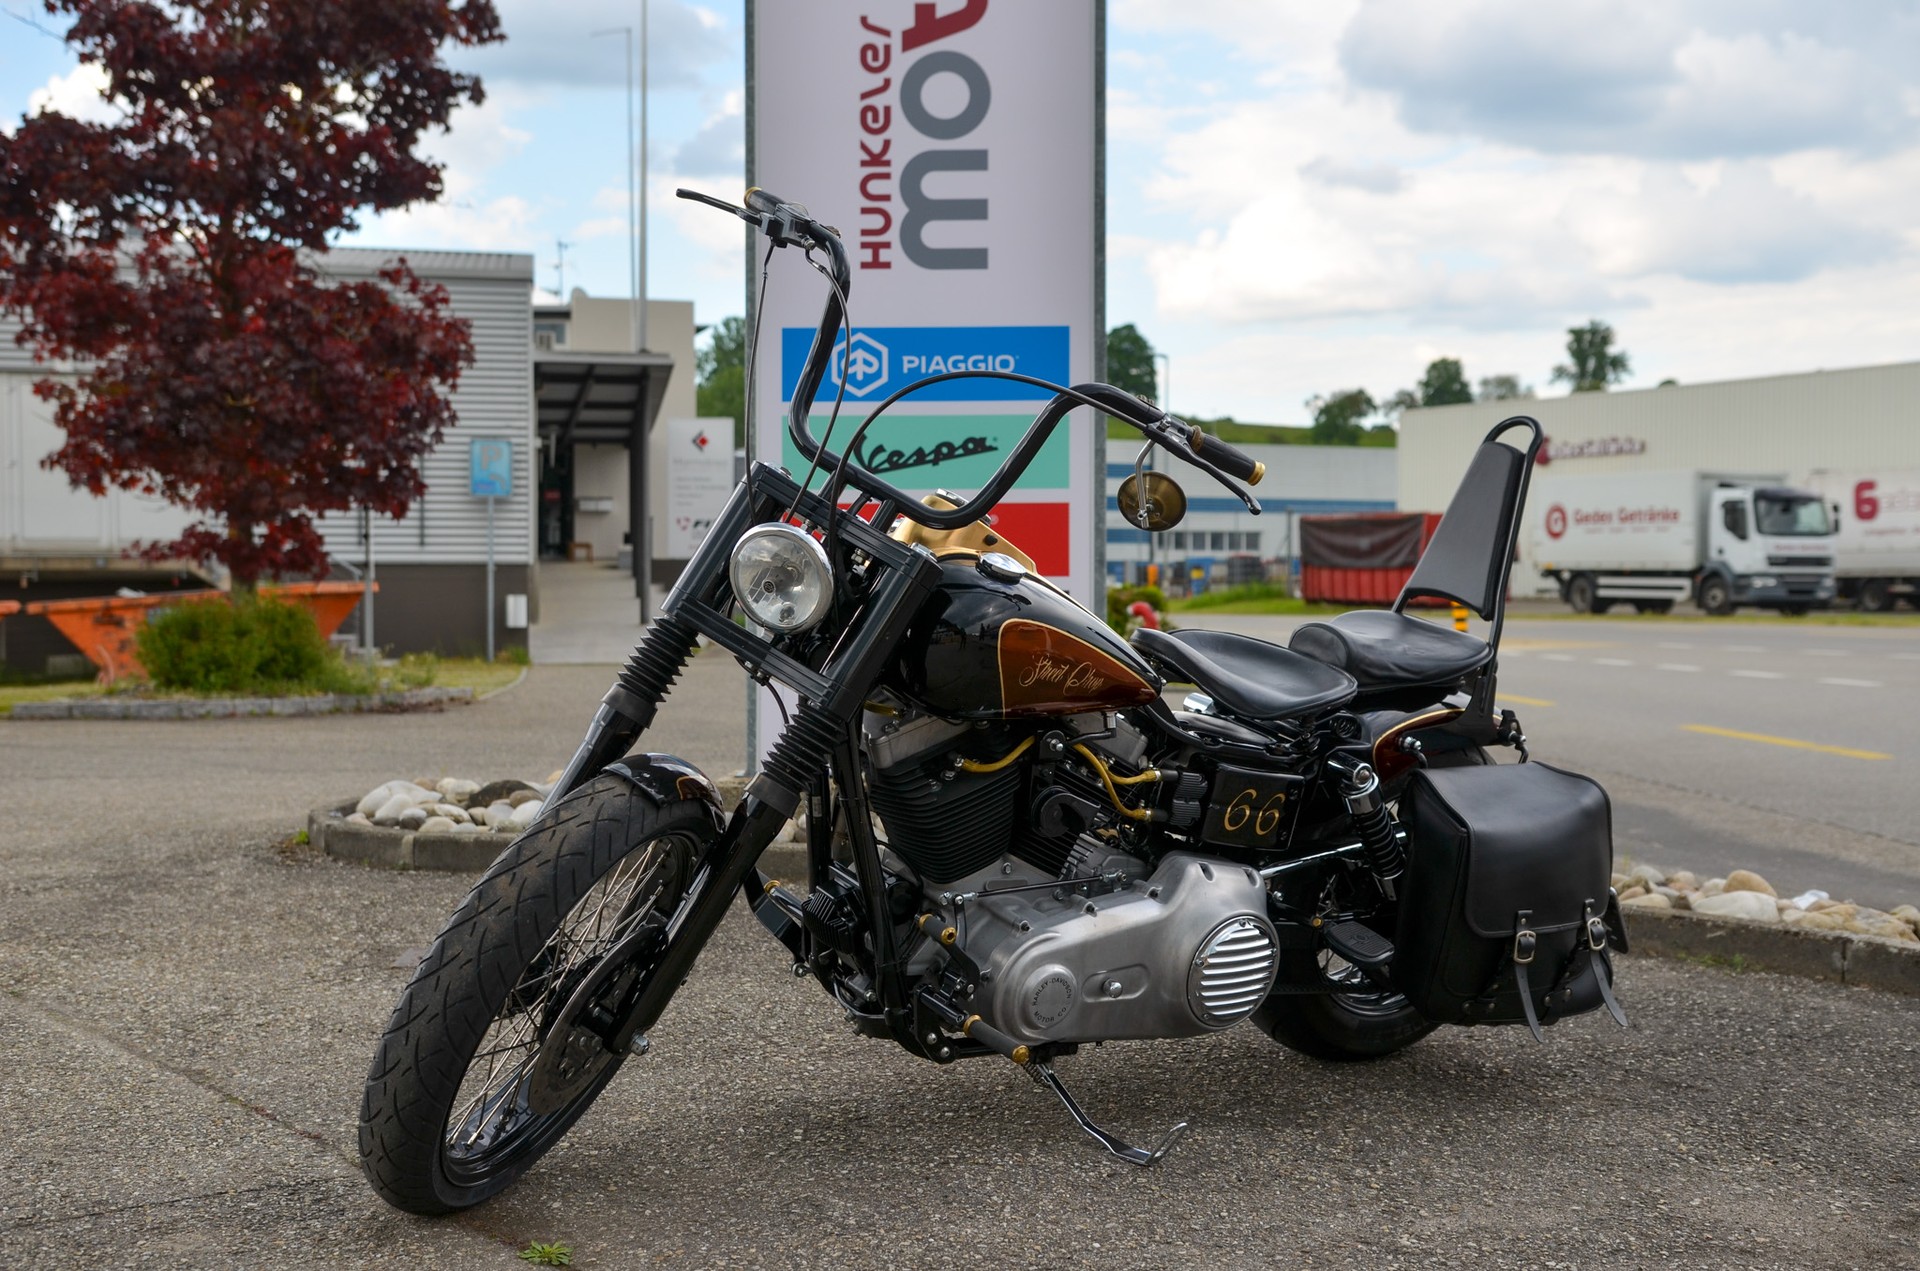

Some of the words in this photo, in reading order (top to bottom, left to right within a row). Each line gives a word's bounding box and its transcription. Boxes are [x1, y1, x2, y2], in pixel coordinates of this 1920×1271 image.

[902, 354, 1016, 374] PIAGGIO
[854, 433, 999, 474] Vespa
[1224, 789, 1286, 836] 66
[1032, 977, 1072, 1006] HARLEY-DAVIDSON
[1034, 1010, 1055, 1023] MOTOR
